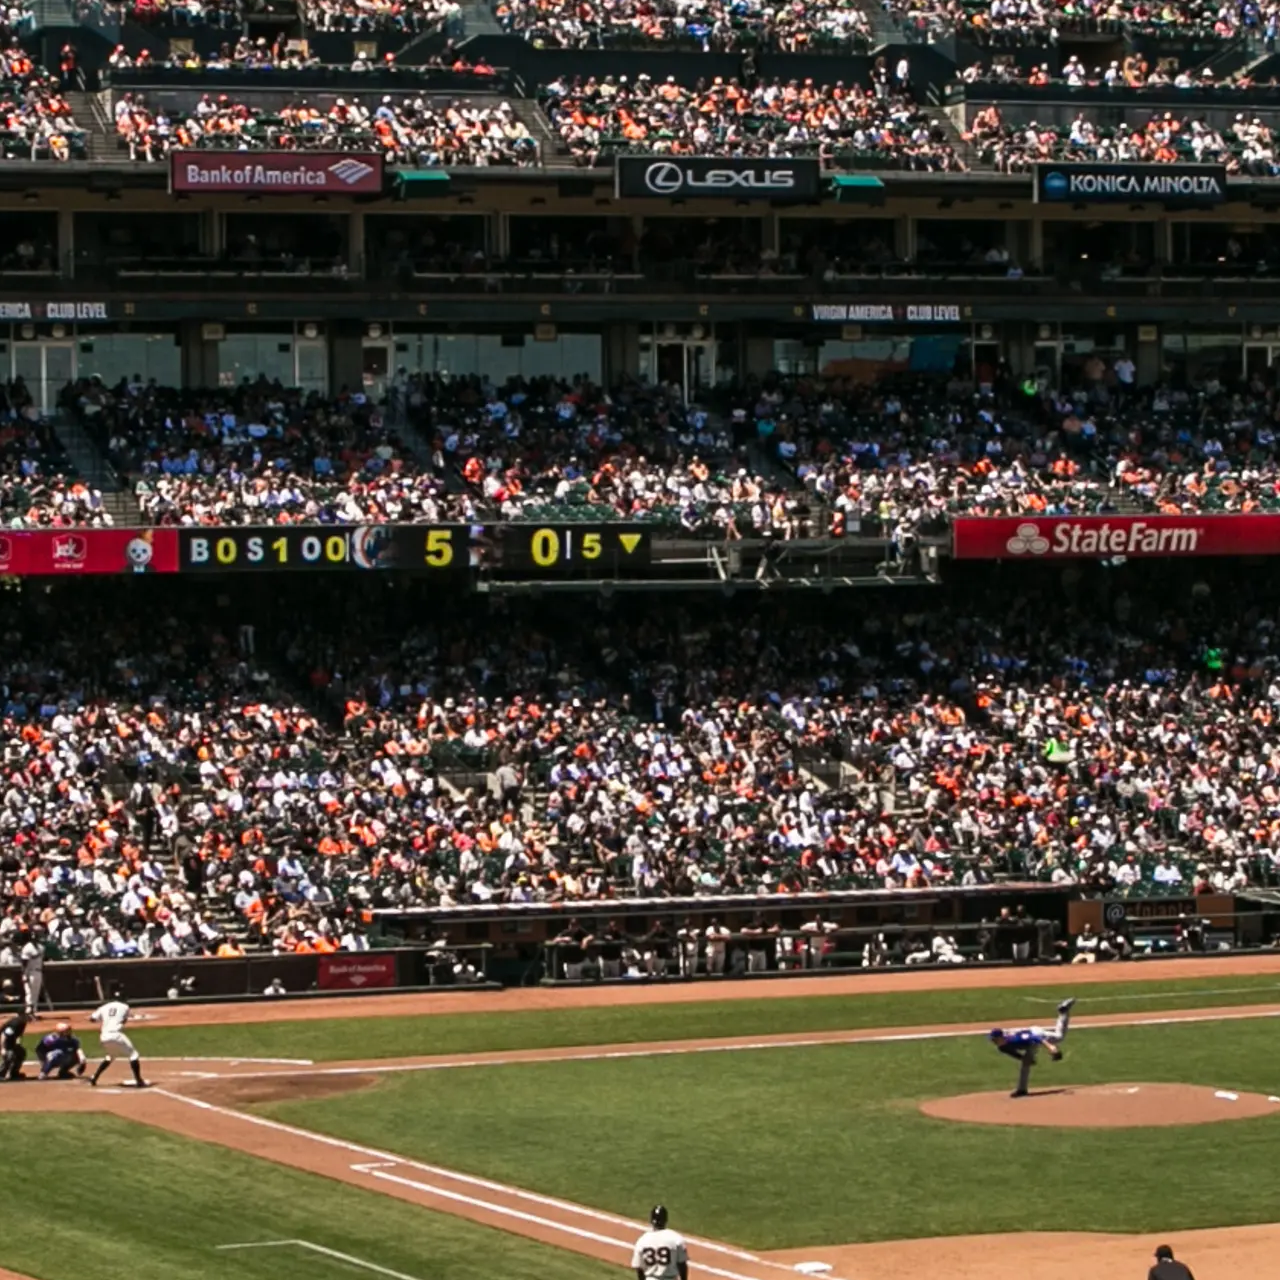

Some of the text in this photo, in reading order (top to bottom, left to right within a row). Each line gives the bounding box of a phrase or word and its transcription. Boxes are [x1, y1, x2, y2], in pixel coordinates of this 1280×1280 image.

[187, 165, 326, 185] Bank of America
[687, 170, 794, 187] LEXUS
[1070, 175, 1221, 194] KONICA MINOLTA
[77, 301, 107, 319] LEVEL
[848, 304, 894, 320] AMERICA
[933, 304, 960, 320] LEVEL
[425, 529, 453, 566] 5
[531, 528, 602, 566] 0 5
[642, 1246, 671, 1267] 39
